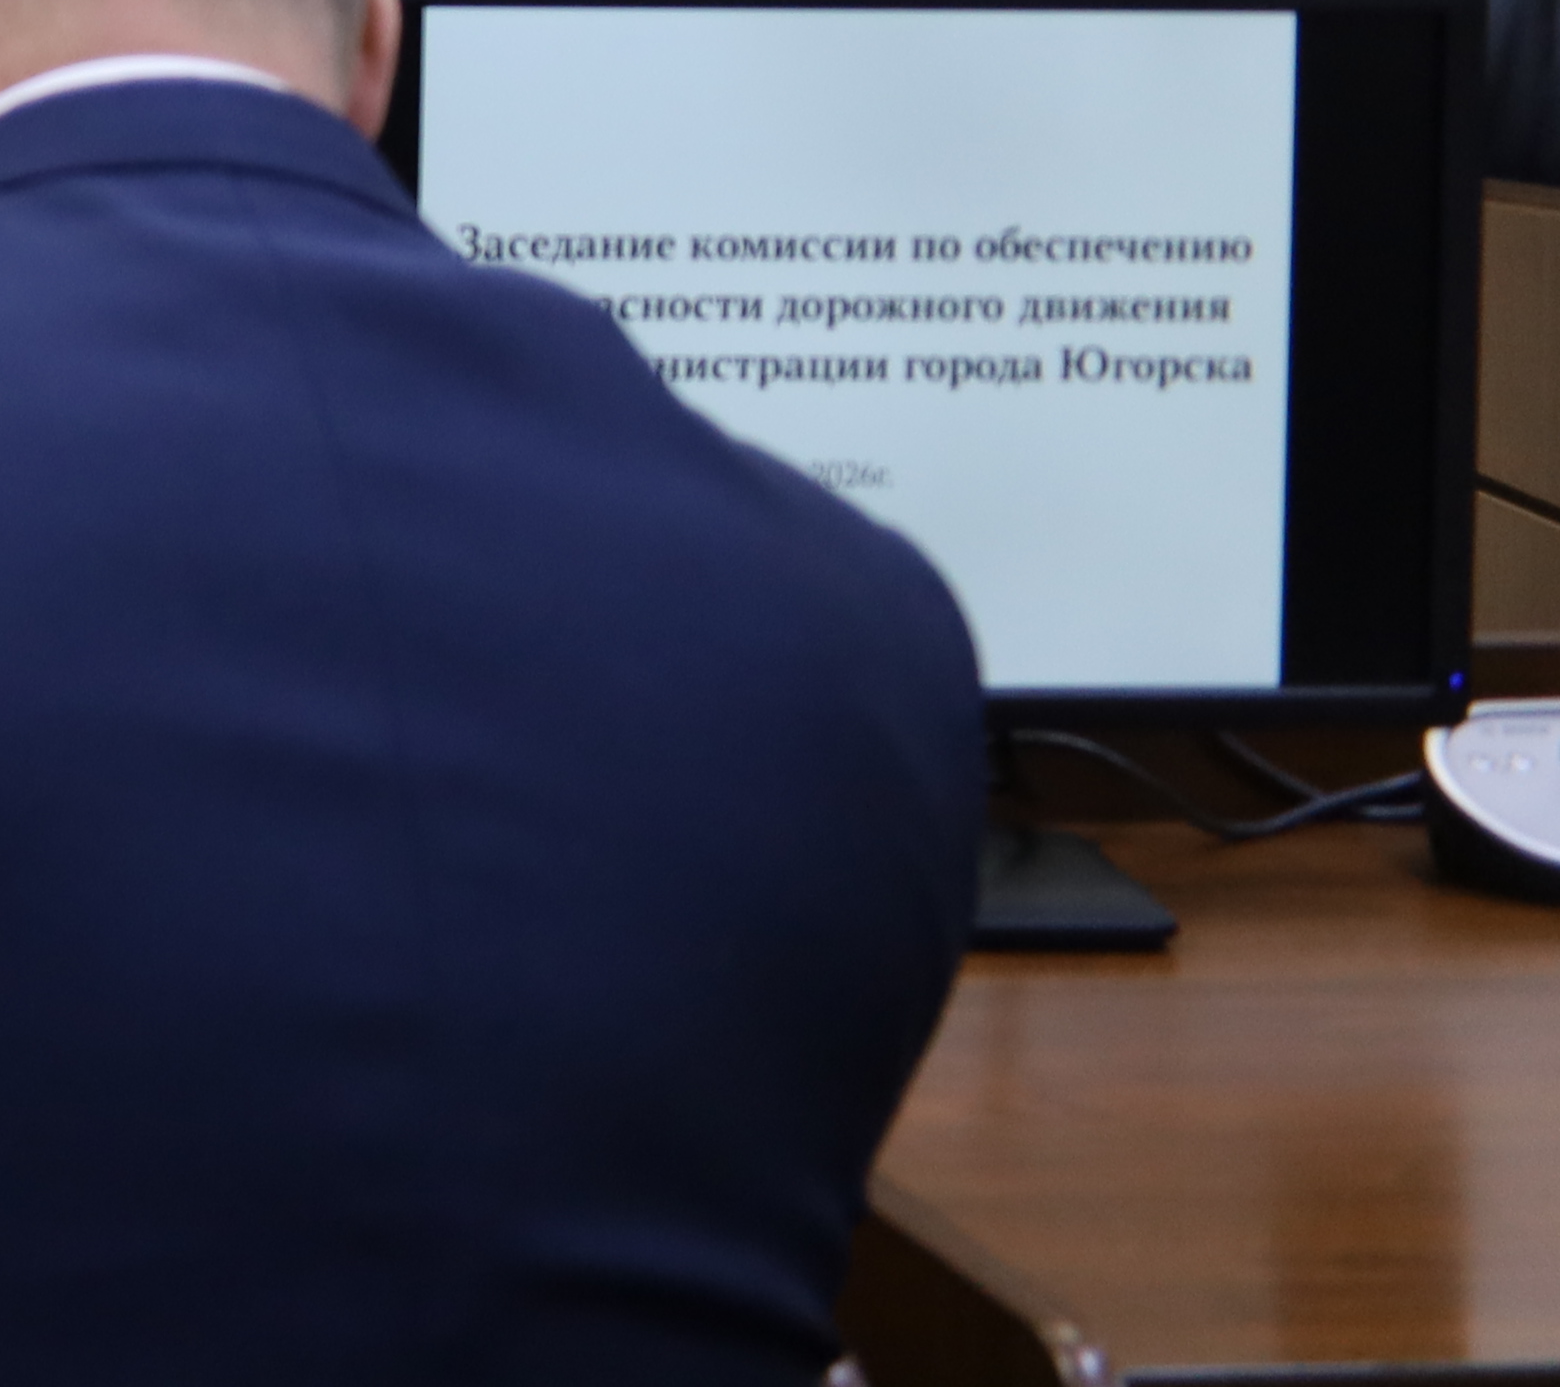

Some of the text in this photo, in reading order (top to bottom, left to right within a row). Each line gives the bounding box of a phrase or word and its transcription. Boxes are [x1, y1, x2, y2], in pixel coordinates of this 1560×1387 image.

[459, 223, 1254, 265] Заседание комиссии по обеспечению
[775, 295, 1006, 331] дорожного
[1017, 296, 1232, 328] движения
[904, 354, 1044, 392] города
[1059, 345, 1253, 392] Югорска
